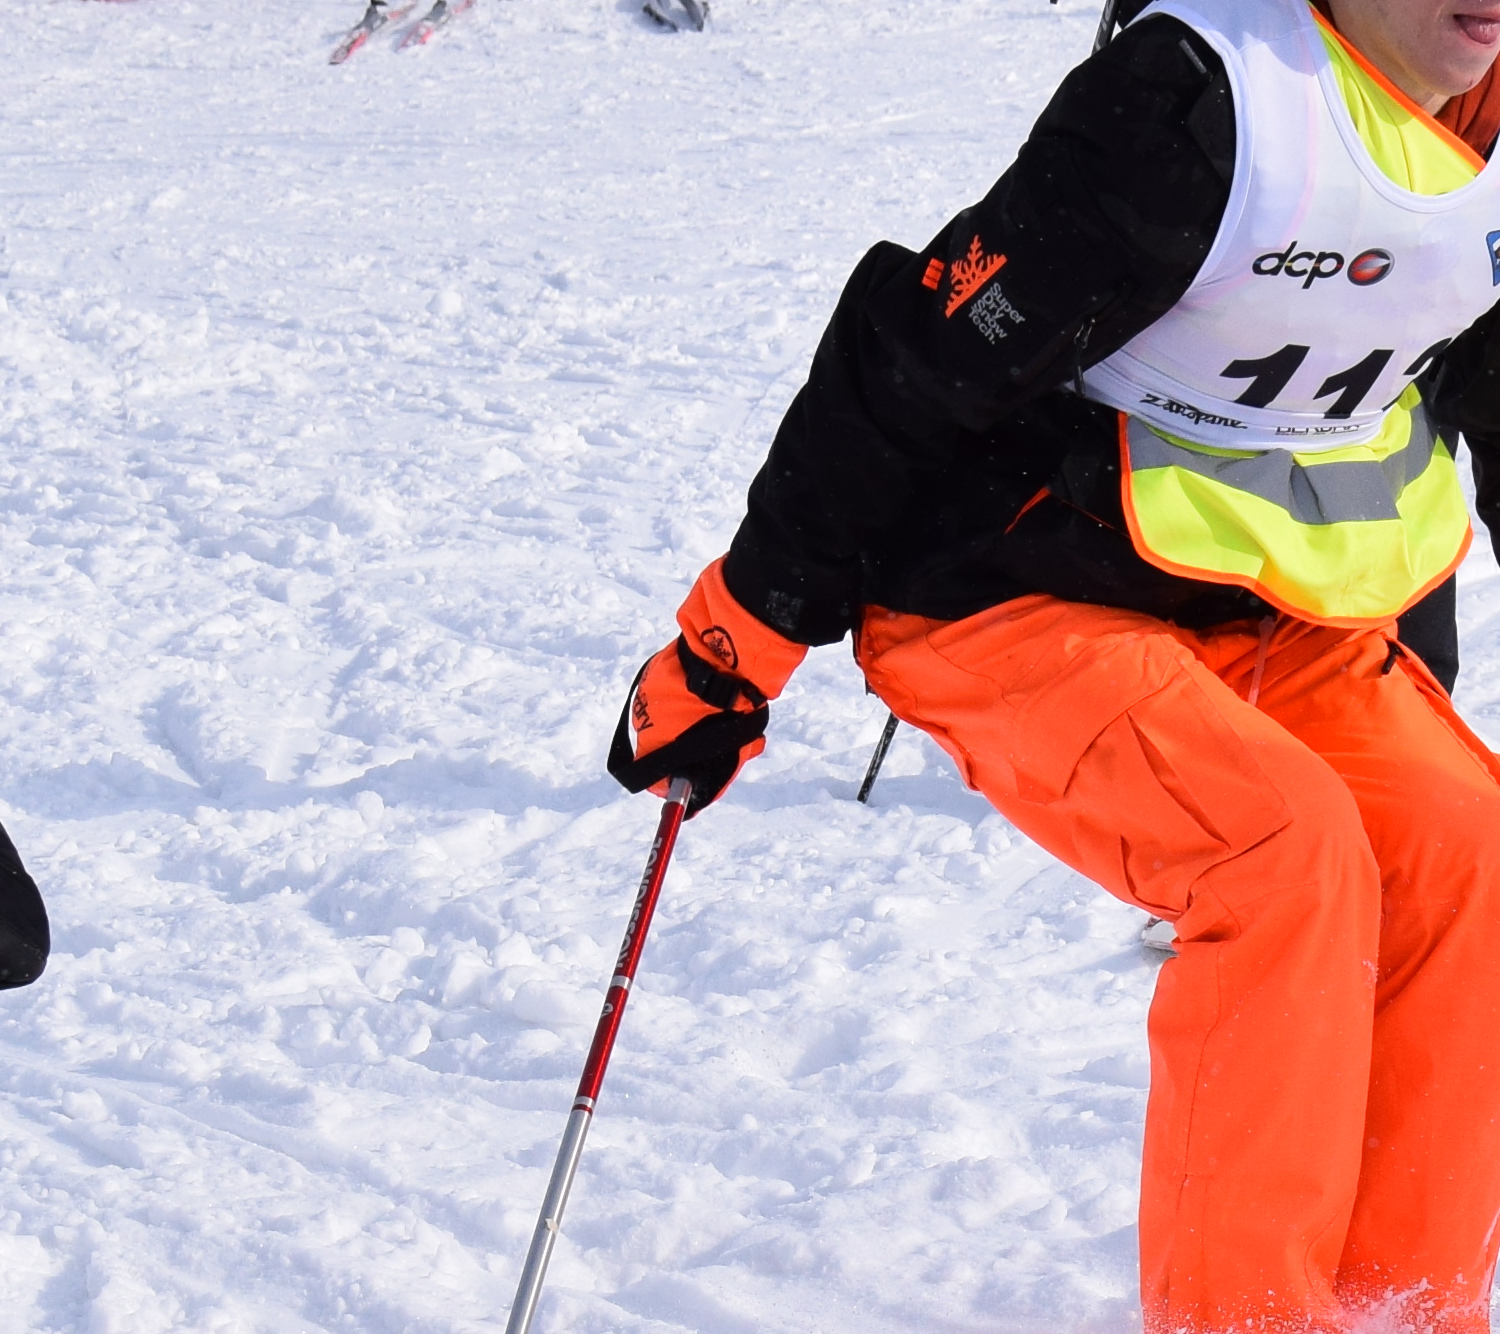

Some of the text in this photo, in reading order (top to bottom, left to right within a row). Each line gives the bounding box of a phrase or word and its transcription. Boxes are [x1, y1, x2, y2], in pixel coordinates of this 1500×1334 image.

[1252, 241, 1345, 290] dcp
[974, 299, 1007, 339] Snow
[982, 290, 1005, 320] Dry
[990, 282, 1026, 324] Super
[968, 306, 996, 345] Tech.
